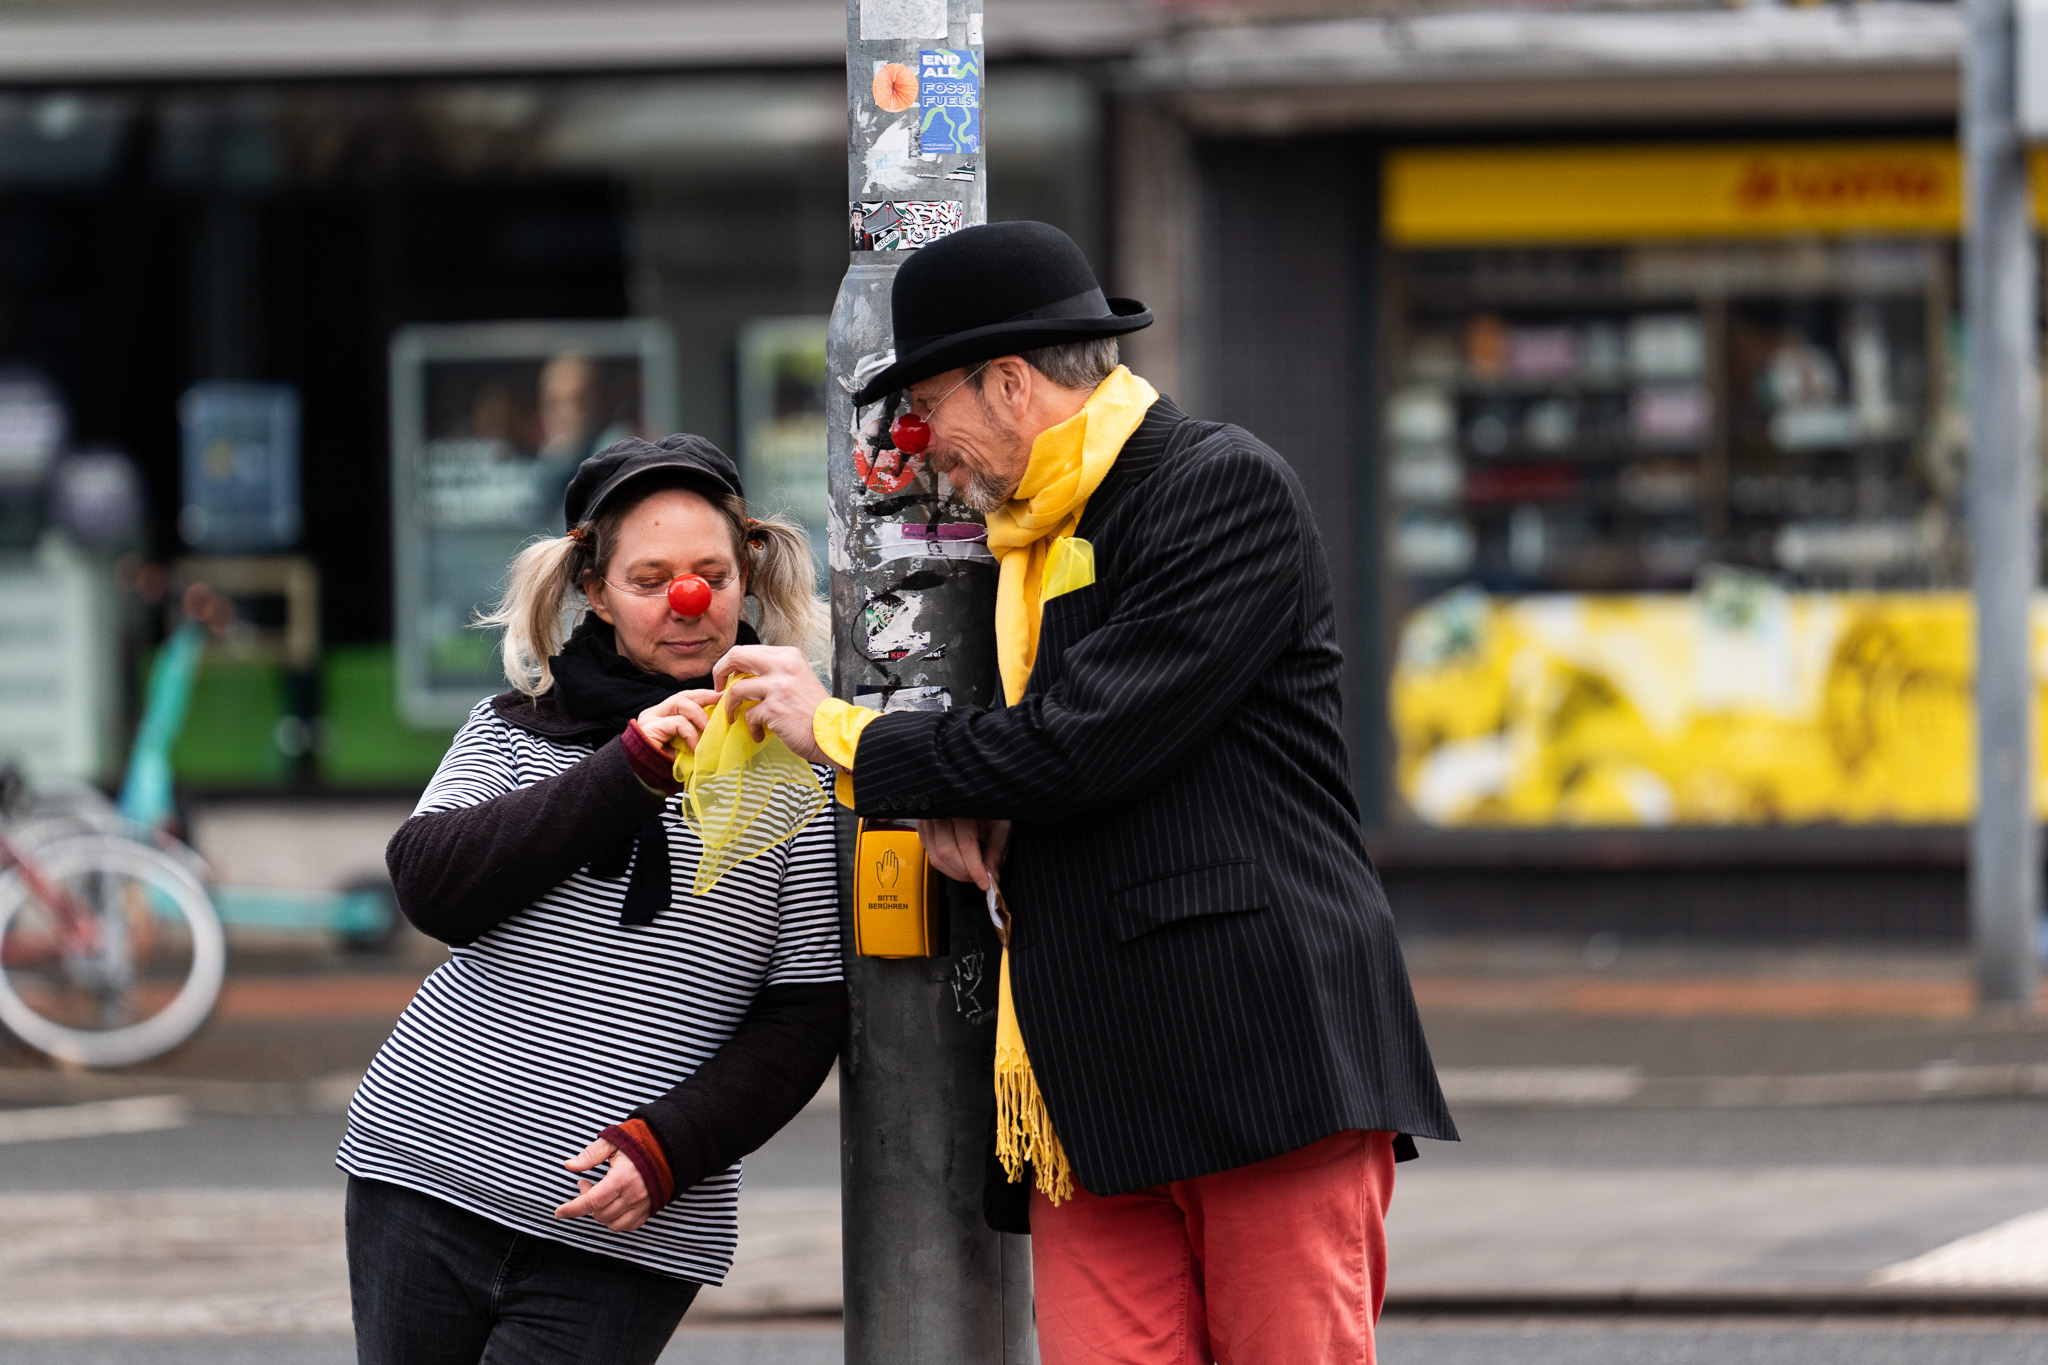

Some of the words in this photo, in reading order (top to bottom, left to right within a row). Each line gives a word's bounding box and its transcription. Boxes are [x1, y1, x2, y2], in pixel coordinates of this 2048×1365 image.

[922, 55, 960, 66] END
[922, 67, 959, 78] ALL
[922, 82, 976, 95] FOSSIL
